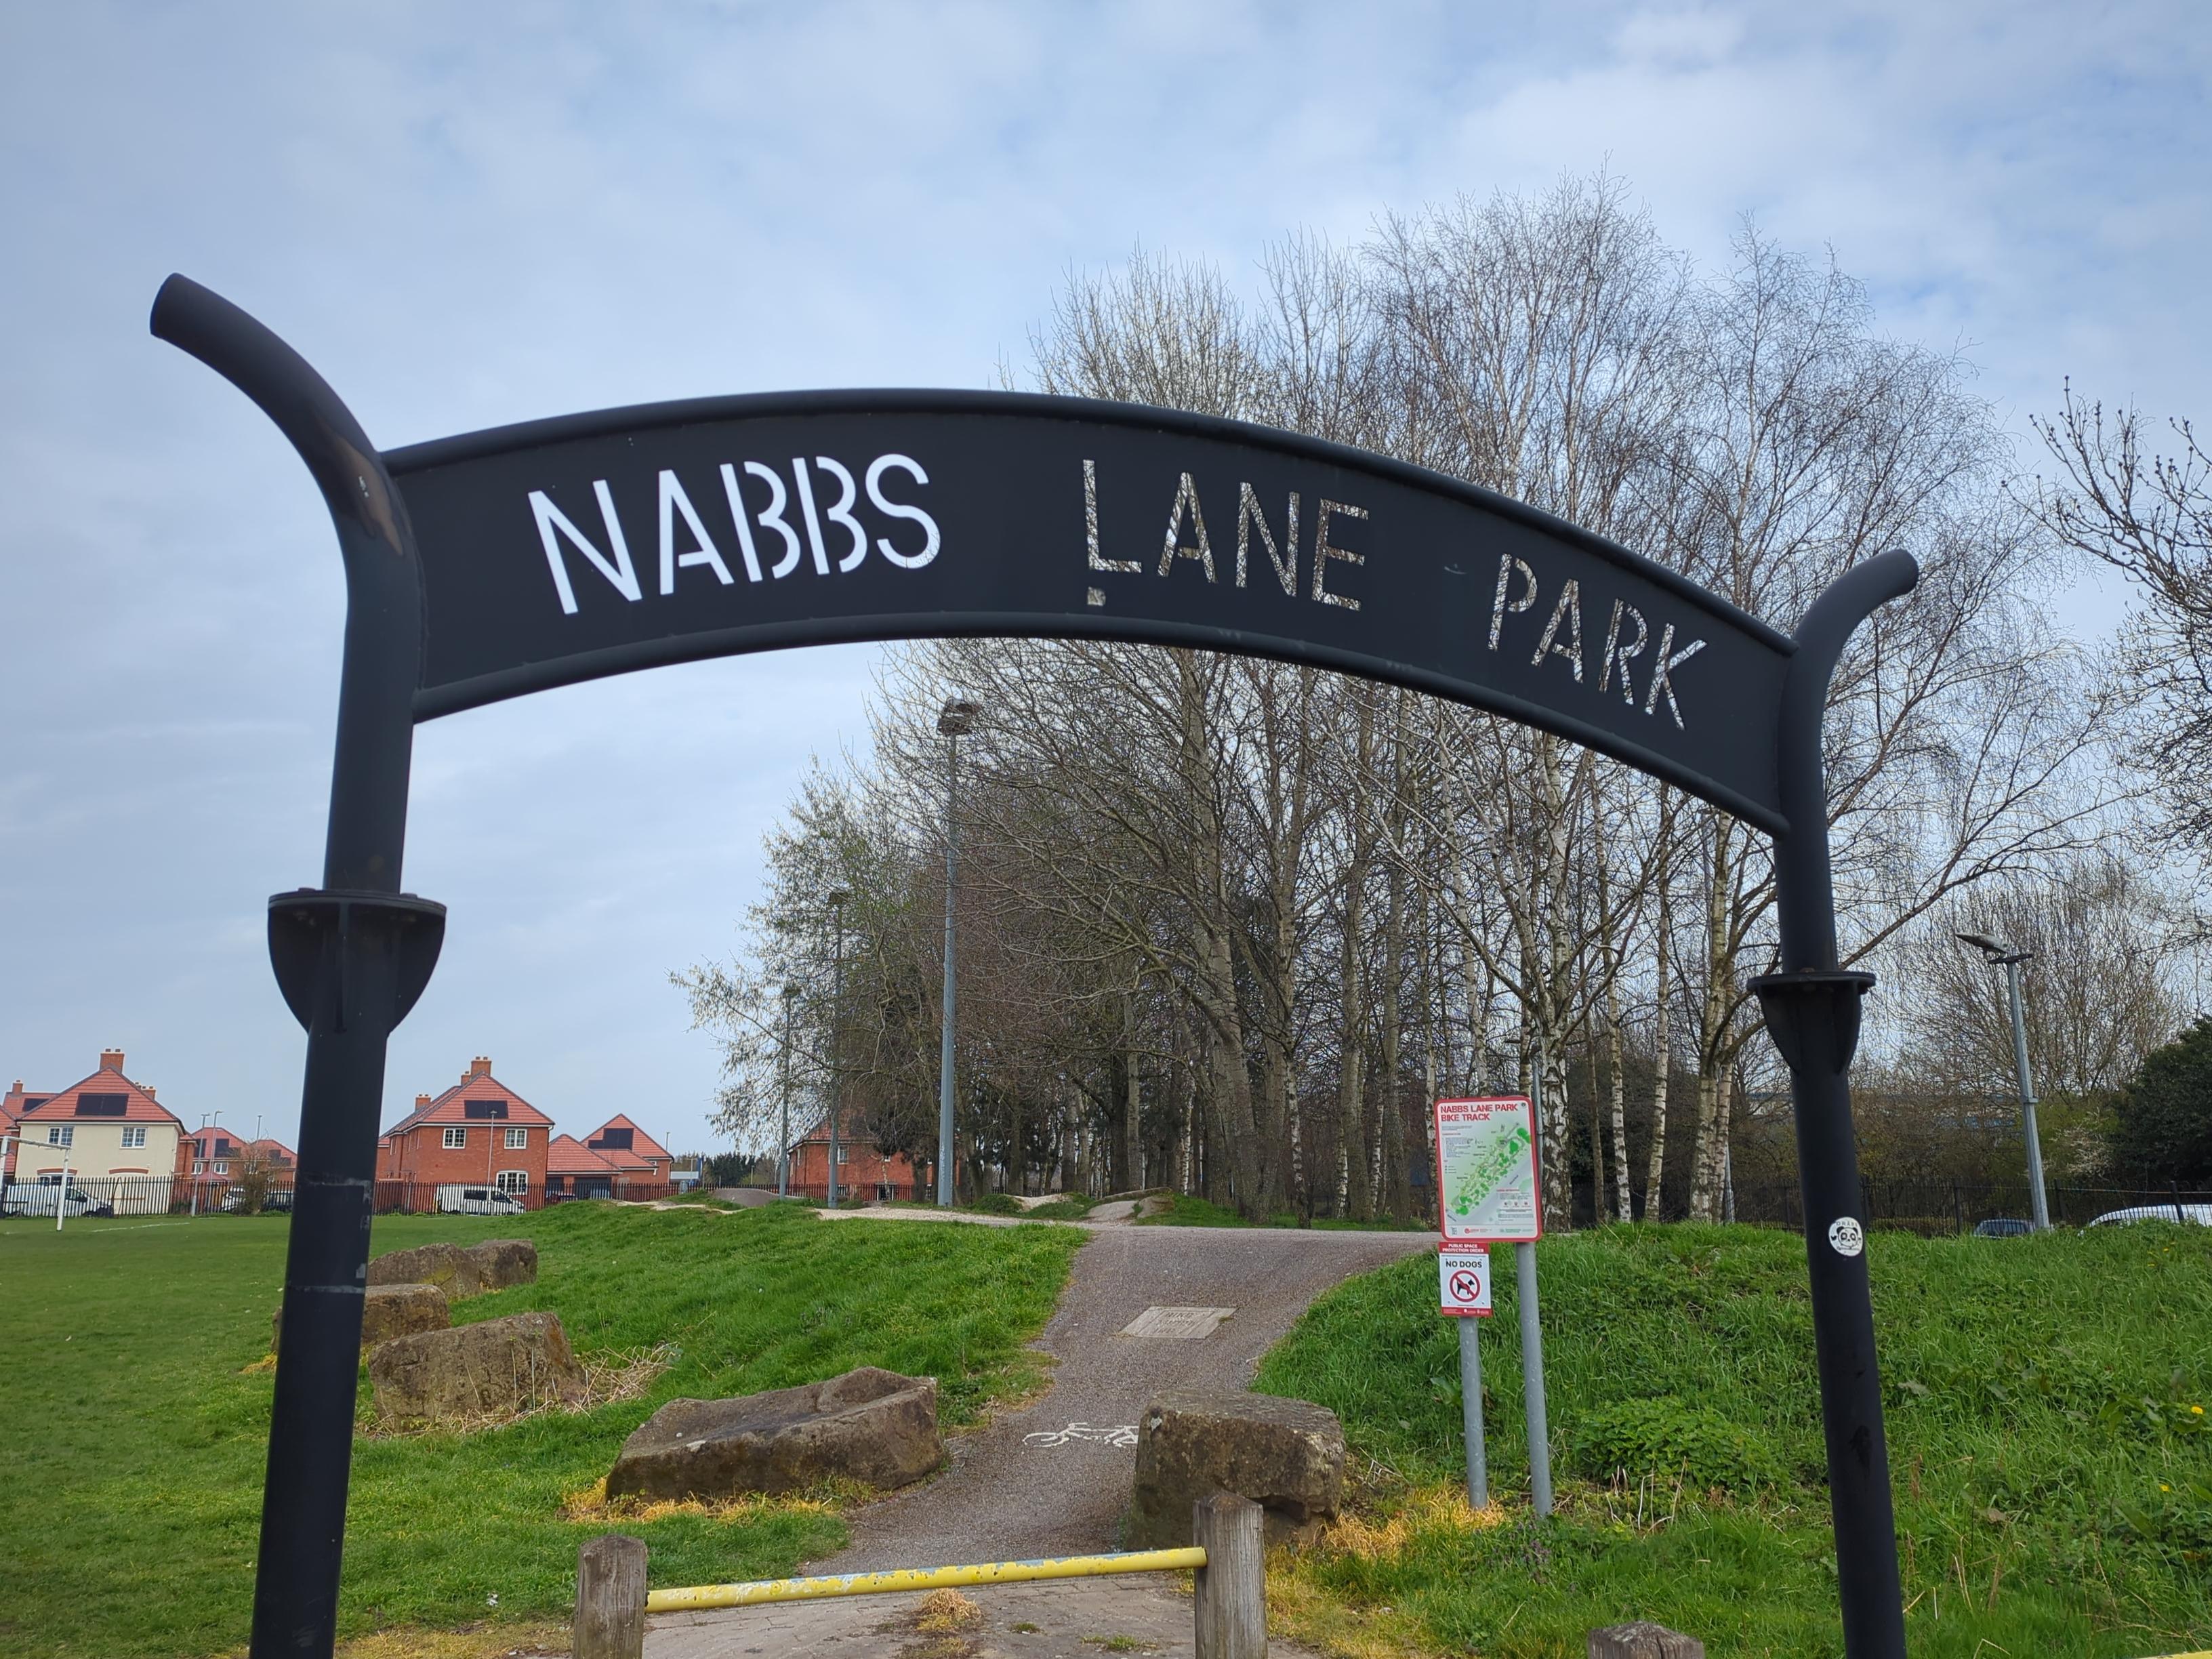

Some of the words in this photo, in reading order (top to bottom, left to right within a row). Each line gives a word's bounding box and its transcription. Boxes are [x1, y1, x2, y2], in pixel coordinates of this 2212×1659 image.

[528, 453, 941, 615] NABBS
[1082, 458, 1369, 611] LANE
[1488, 552, 1708, 731] PARK
